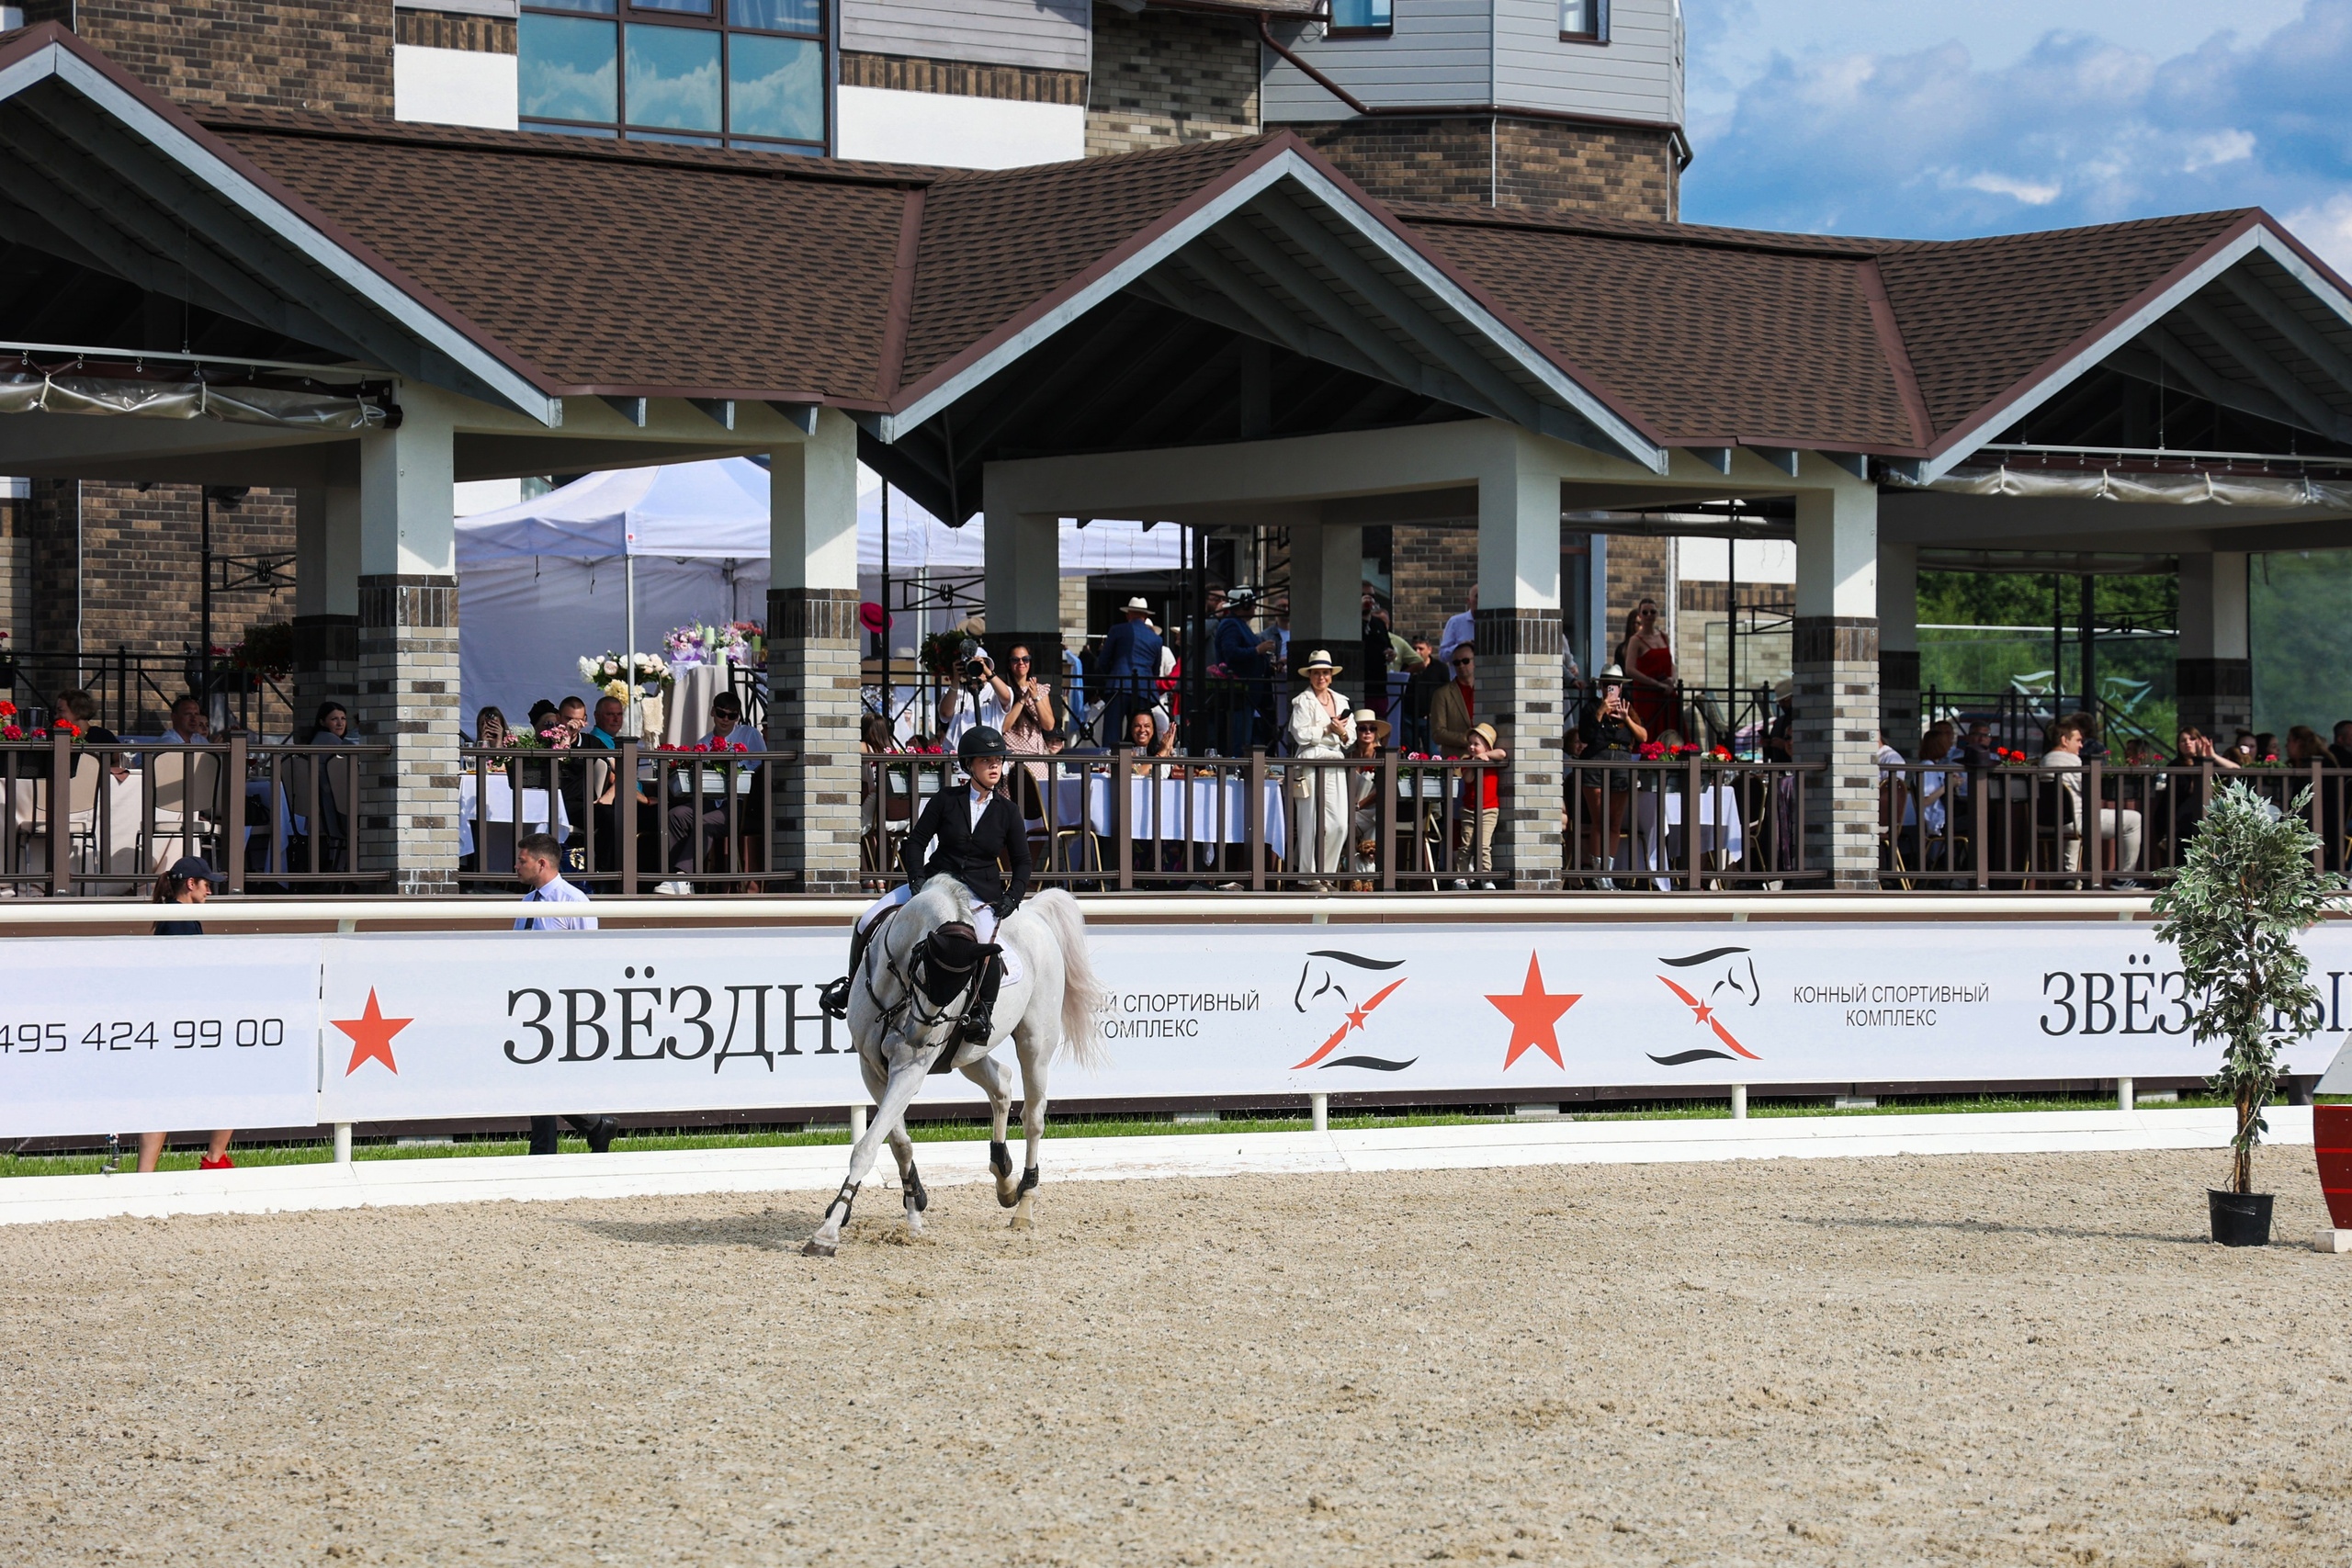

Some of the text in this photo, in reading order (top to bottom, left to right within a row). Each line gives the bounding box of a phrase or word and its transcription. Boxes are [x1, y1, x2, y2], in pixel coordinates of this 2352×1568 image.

[1124, 988, 1260, 1012] СПОРТИВНЫЙ
[1793, 982, 1989, 1003] КОННЫЙ СПОРТИВНЫЙ
[2040, 953, 2352, 1048] ЗВЁЗЫ
[503, 965, 859, 1075] ЗВЁЗДН
[1846, 1009, 1937, 1027] КОМПЛЕКС
[0, 1018, 284, 1054] 495 424 99 00
